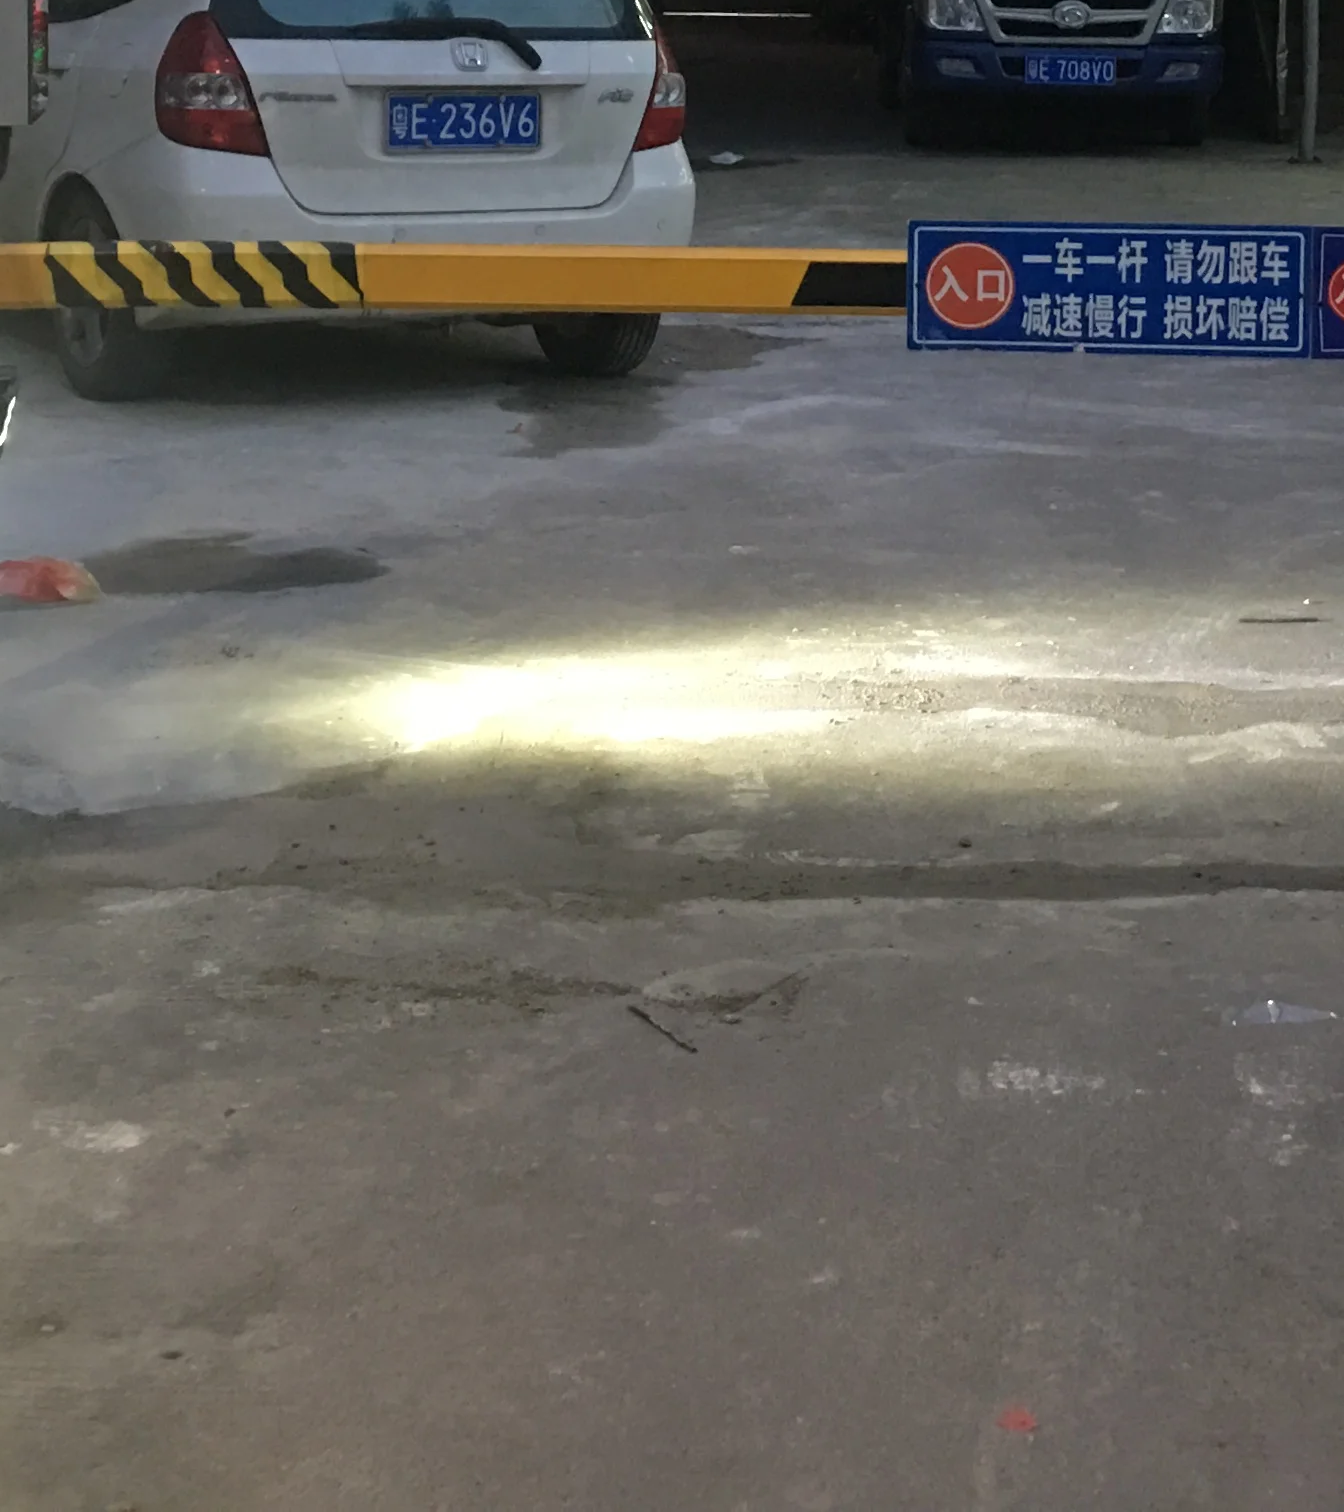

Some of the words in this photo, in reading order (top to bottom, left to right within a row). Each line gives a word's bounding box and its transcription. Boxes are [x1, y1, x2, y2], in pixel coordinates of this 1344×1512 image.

[933, 265, 1007, 303] 入口
[1022, 237, 1148, 283] 一车一杆
[1164, 239, 1290, 286] 请勿跟车
[1021, 293, 1148, 340] 减速慢行
[1163, 294, 1291, 342] 损坏赔偿
